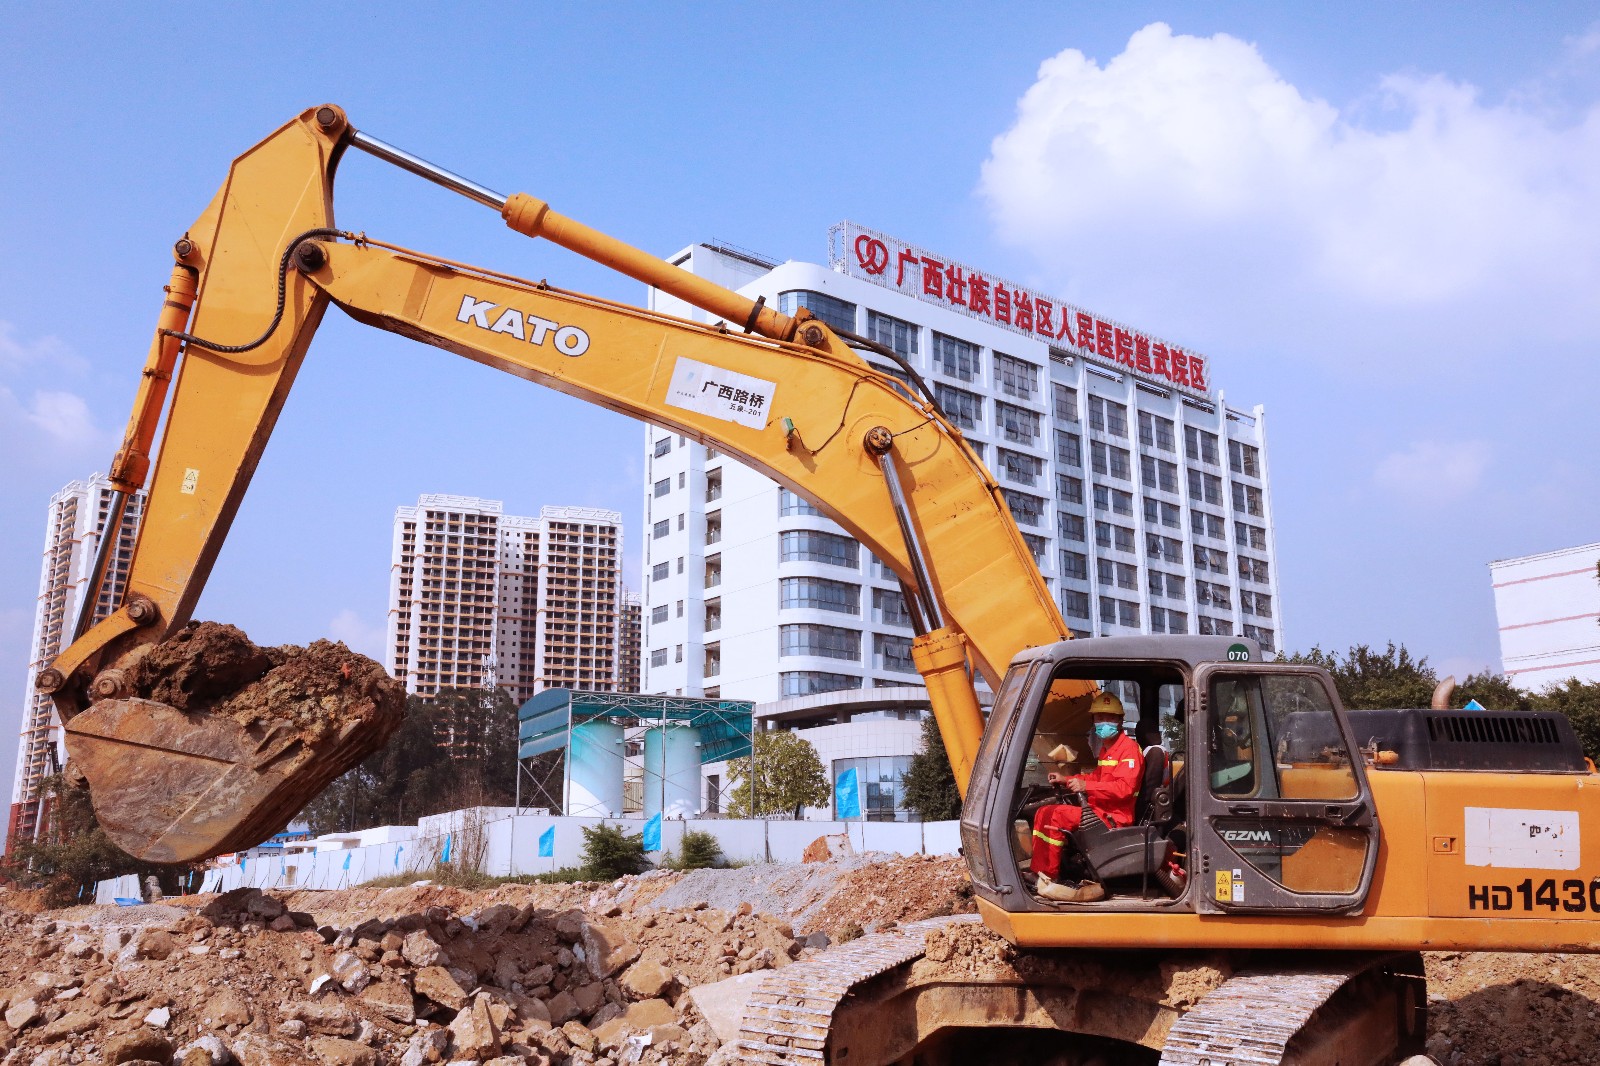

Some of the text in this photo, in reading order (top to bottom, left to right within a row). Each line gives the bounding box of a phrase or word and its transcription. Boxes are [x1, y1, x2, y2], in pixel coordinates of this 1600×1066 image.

[456, 294, 591, 357] KATO
[897, 249, 1206, 392] 广西壮族自治区人民医院邕武院区
[701, 380, 765, 409] 广西路桥
[1228, 651, 1249, 661] 070
